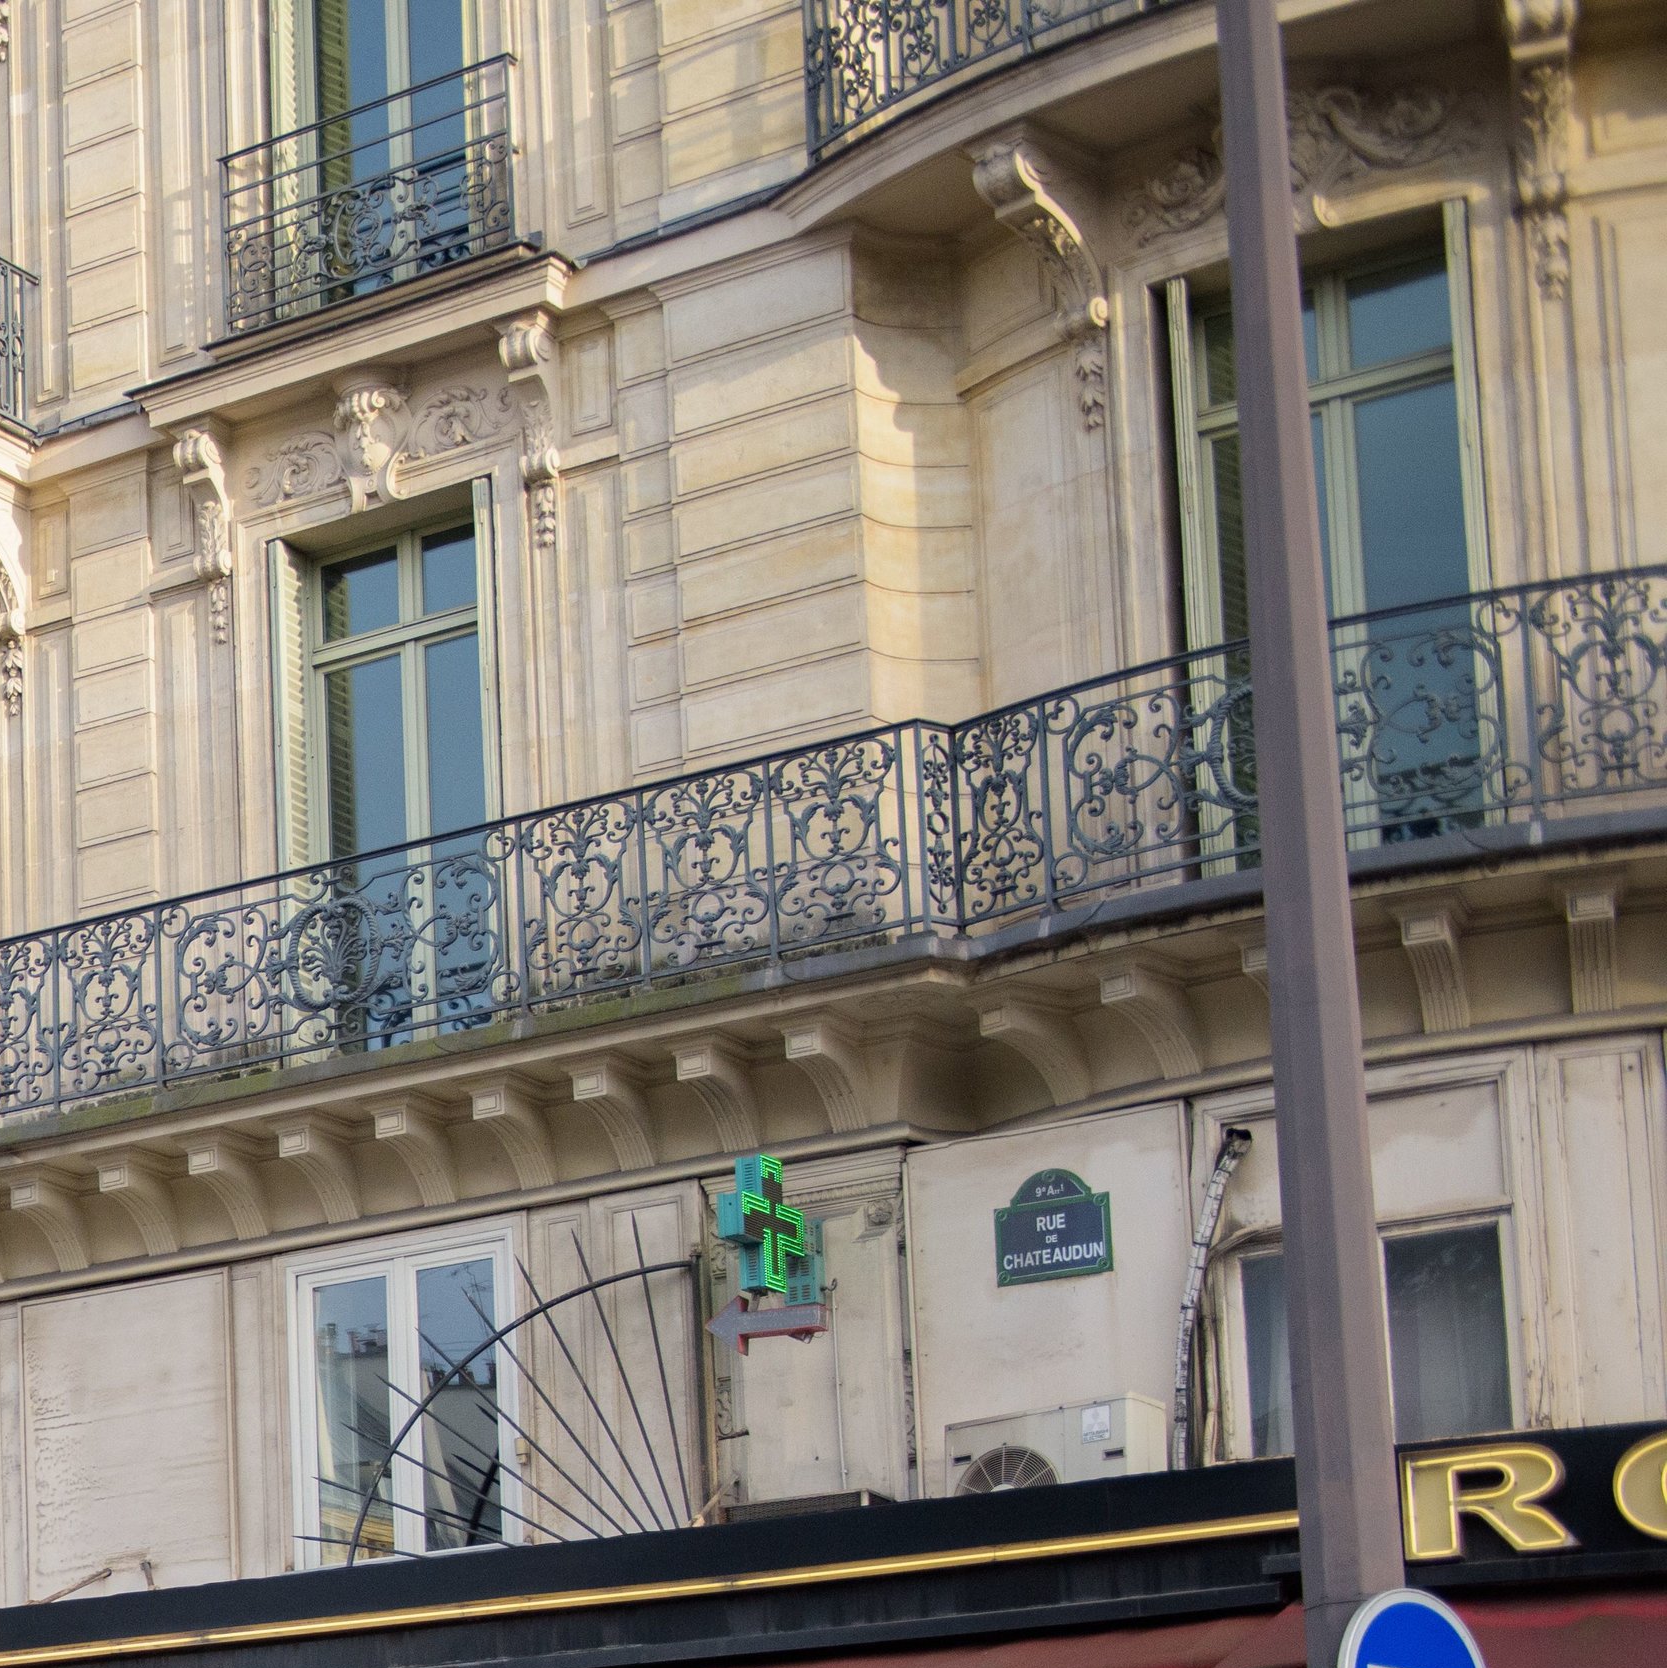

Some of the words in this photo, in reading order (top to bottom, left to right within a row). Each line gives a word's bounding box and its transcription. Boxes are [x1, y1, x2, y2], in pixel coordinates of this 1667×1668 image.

[1036, 1213, 1065, 1232] RUE
[1045, 1234, 1058, 1244] DE
[1003, 1241, 1104, 1270] CHATEAUDUN
